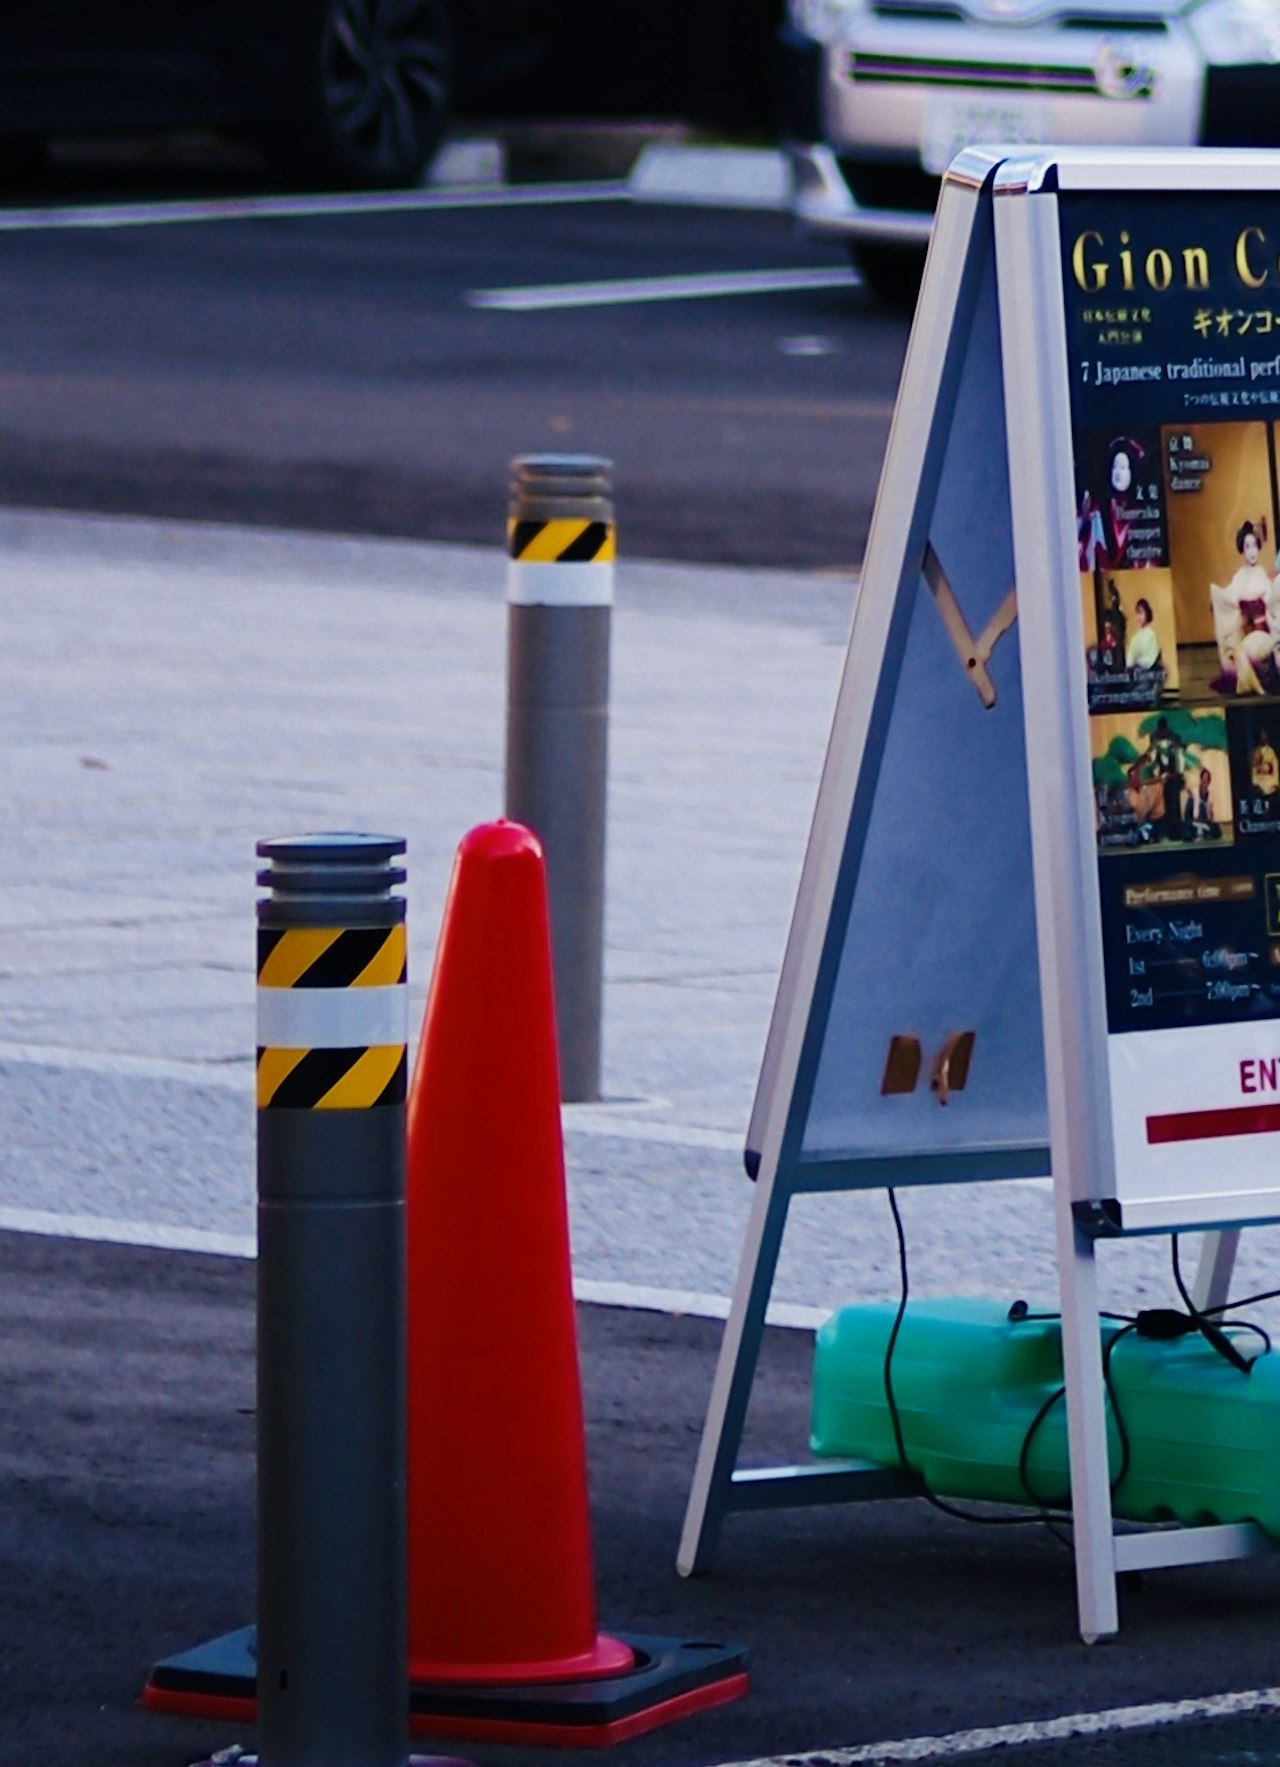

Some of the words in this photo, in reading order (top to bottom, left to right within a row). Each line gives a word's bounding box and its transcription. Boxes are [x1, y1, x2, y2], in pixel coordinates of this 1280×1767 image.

[1072, 230, 1210, 293] Gion
[1081, 360, 1090, 383] 7
[1095, 360, 1162, 386] Japanese
[1167, 356, 1246, 380] traditional
